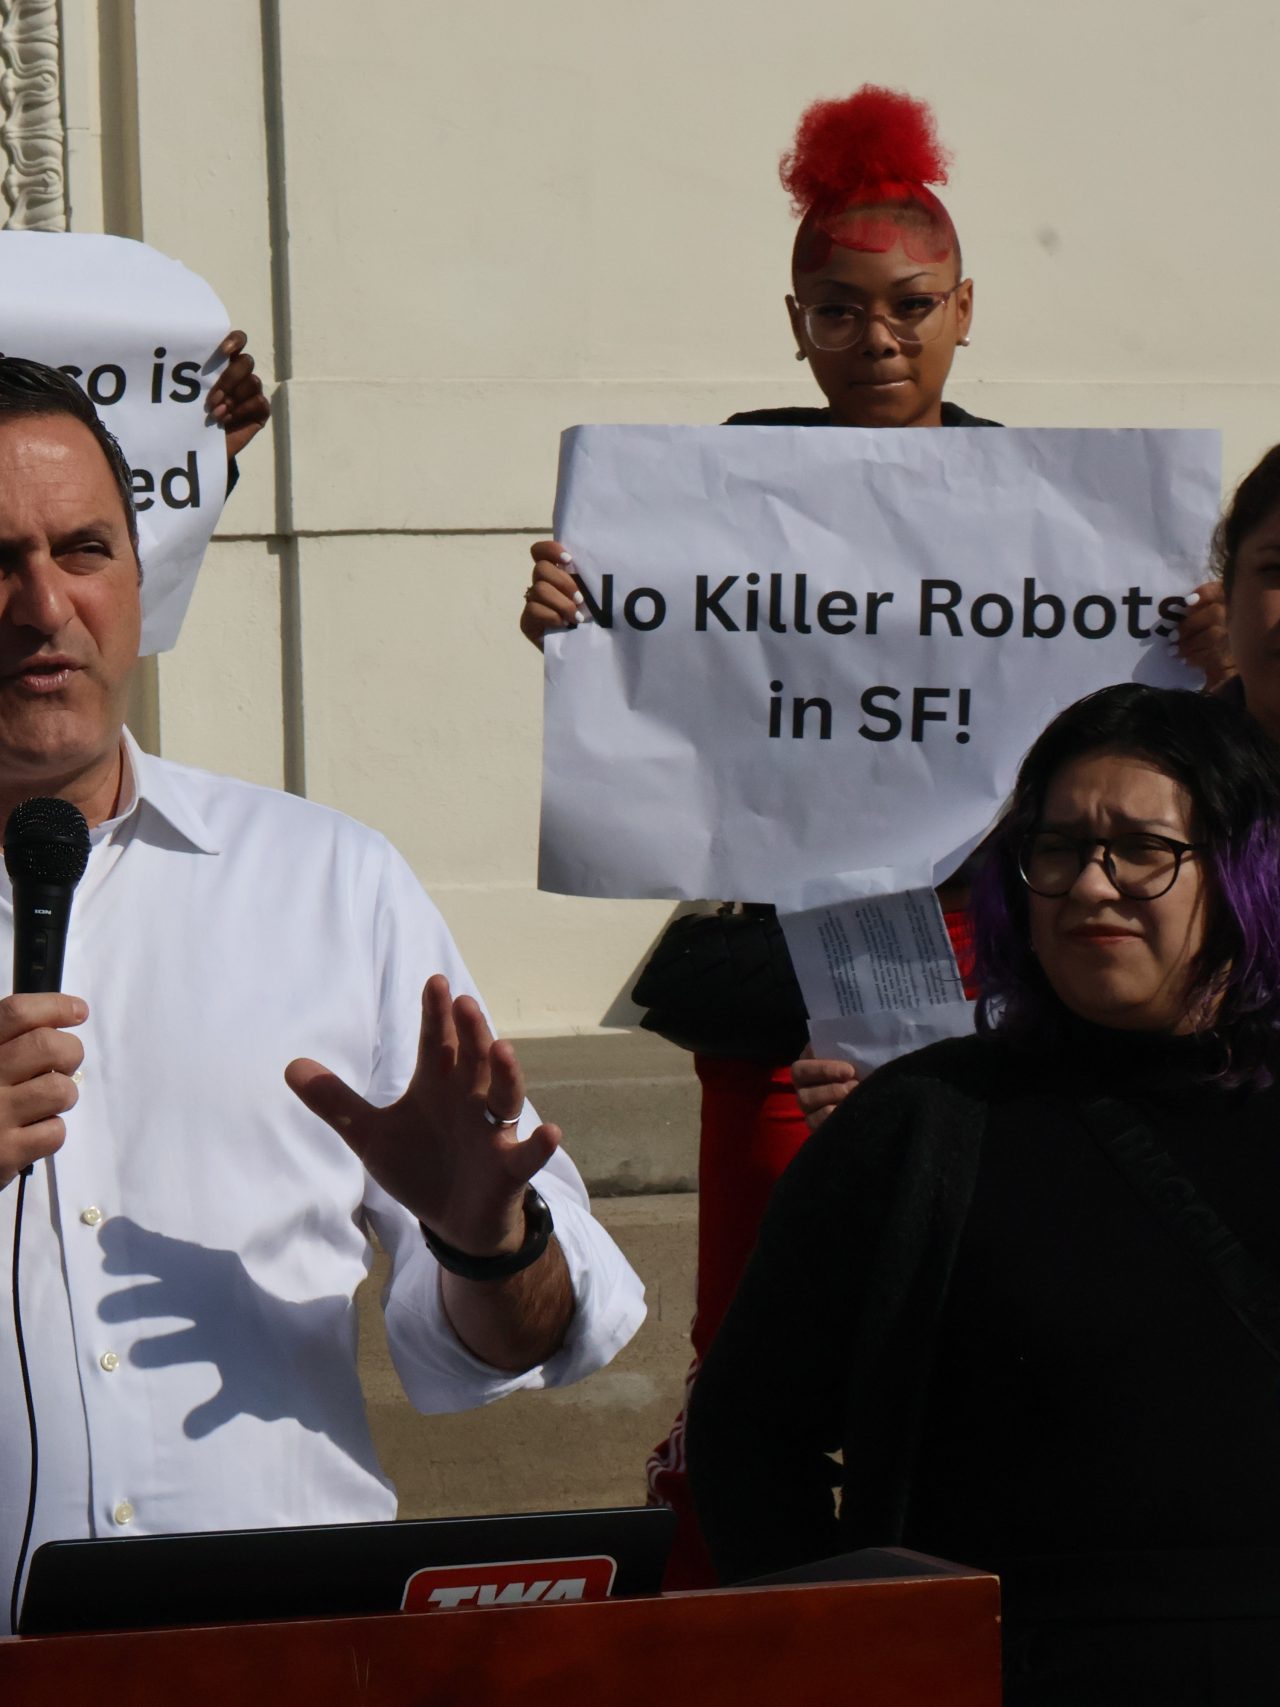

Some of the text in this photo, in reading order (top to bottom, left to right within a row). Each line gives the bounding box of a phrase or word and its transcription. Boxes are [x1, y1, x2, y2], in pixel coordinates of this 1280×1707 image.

[152, 346, 202, 404] is
[568, 572, 1190, 640] No Killer Robots
[768, 679, 972, 745] in SF!
[427, 1577, 587, 1609] TWA
